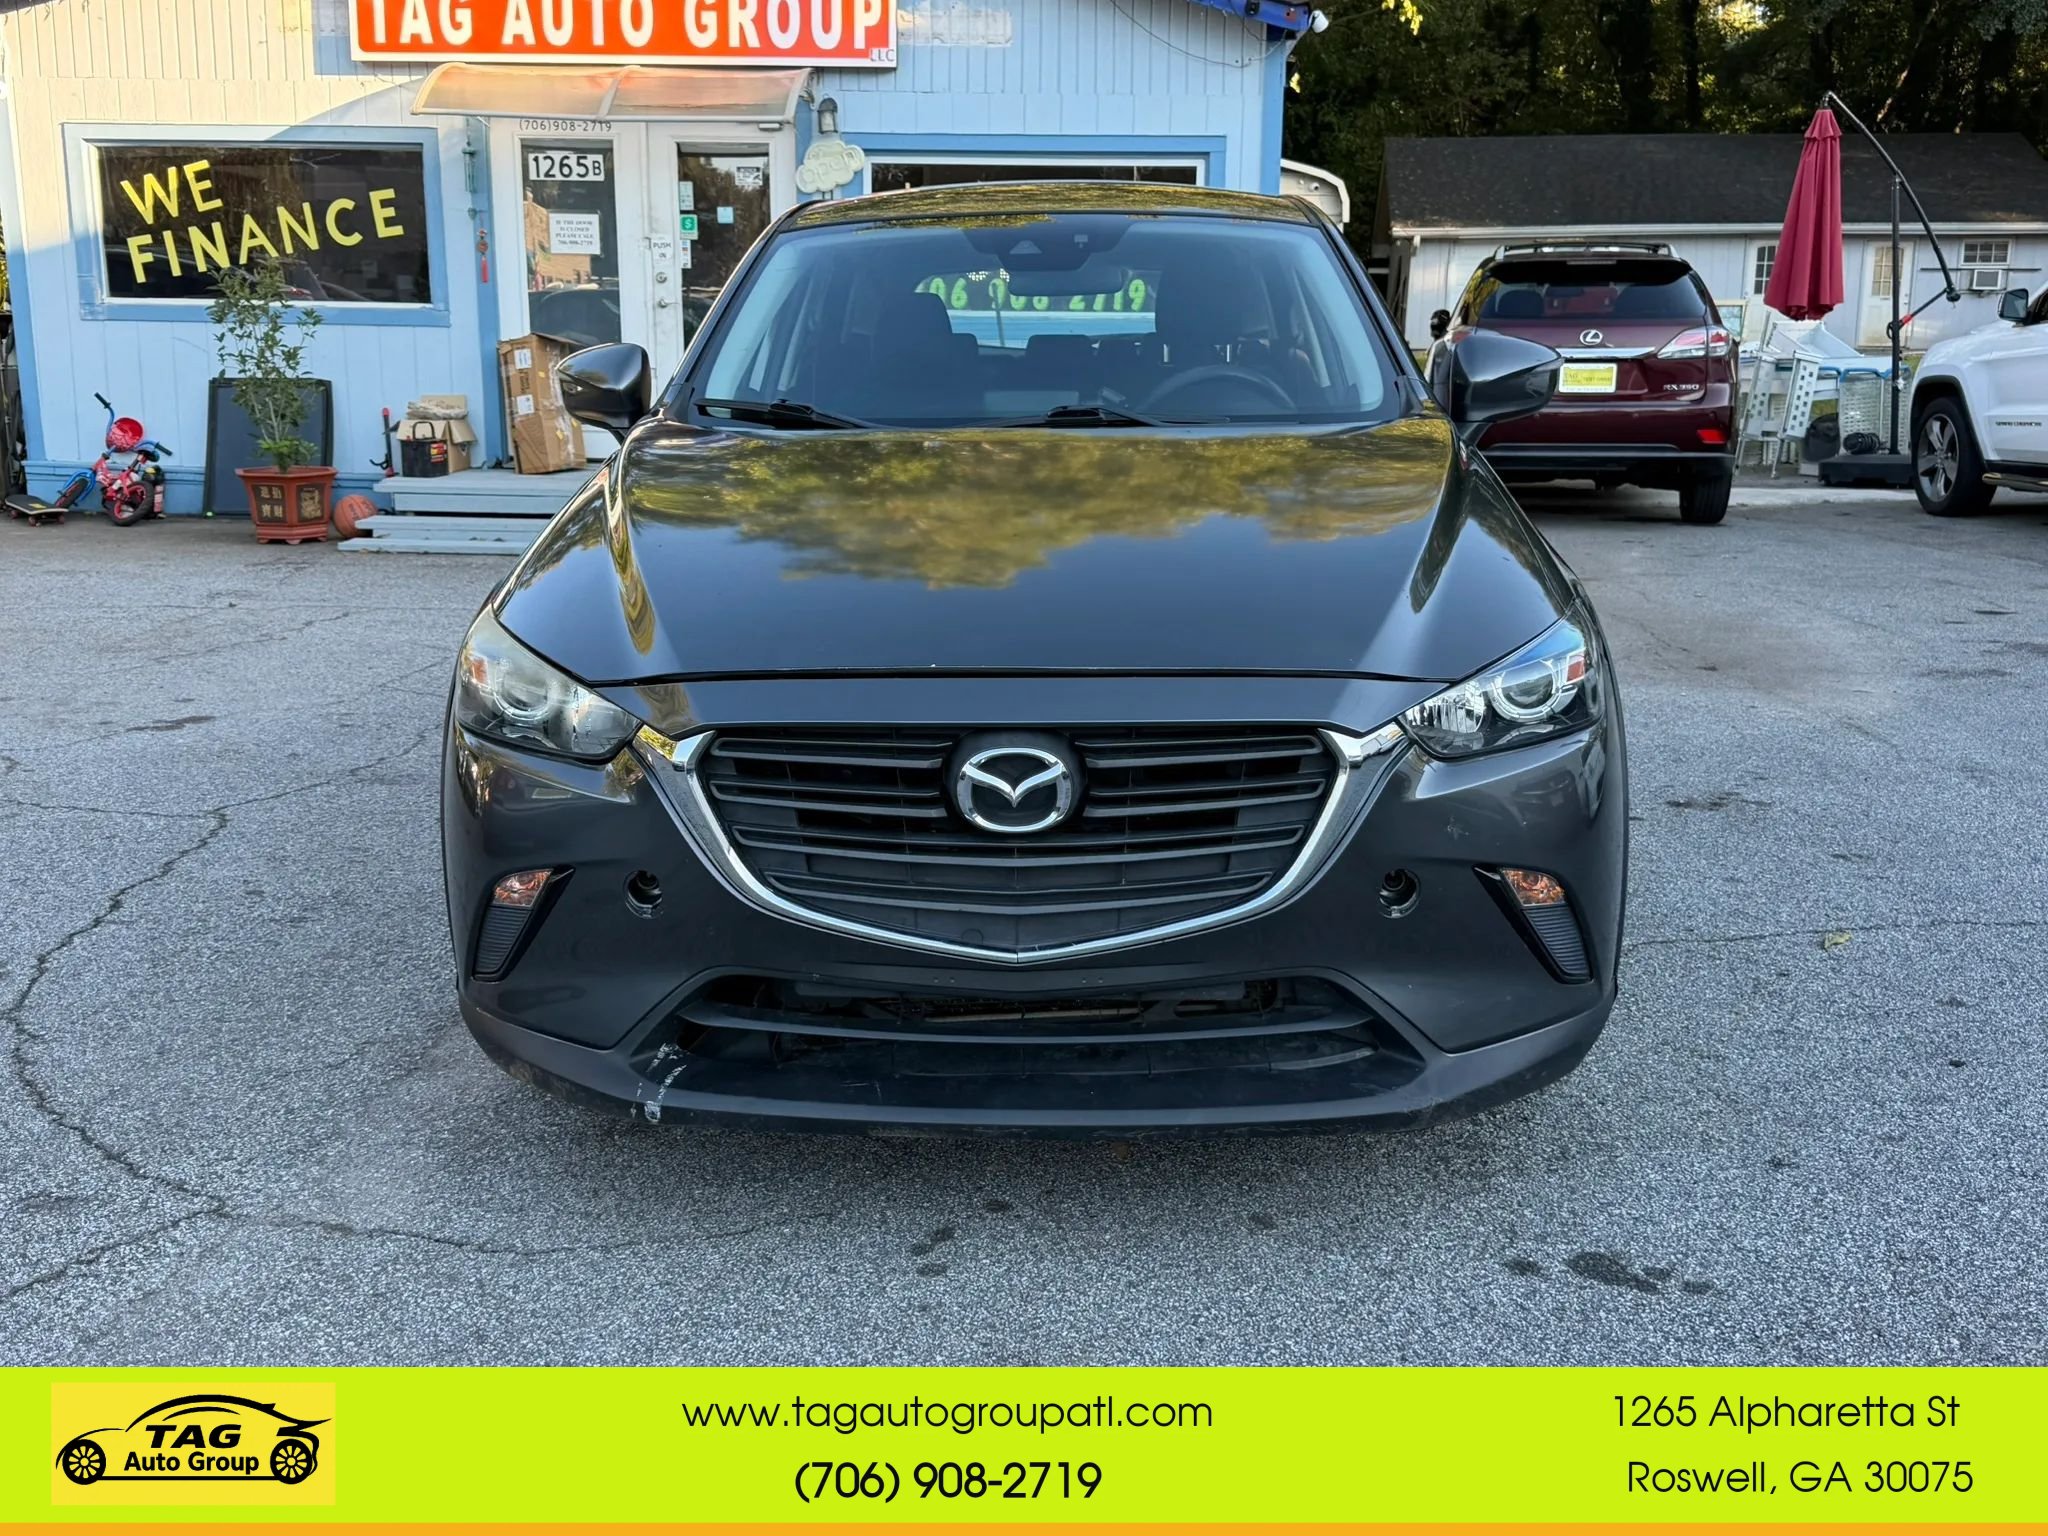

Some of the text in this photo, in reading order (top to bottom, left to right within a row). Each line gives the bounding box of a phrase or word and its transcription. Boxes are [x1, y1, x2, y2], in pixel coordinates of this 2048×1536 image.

[373, 0, 882, 50] TAG AUTO GROUP
[869, 49, 896, 62] LLC
[518, 119, 613, 132] (706)908-2719
[119, 159, 224, 225] WE
[126, 188, 405, 284] FINANCE
